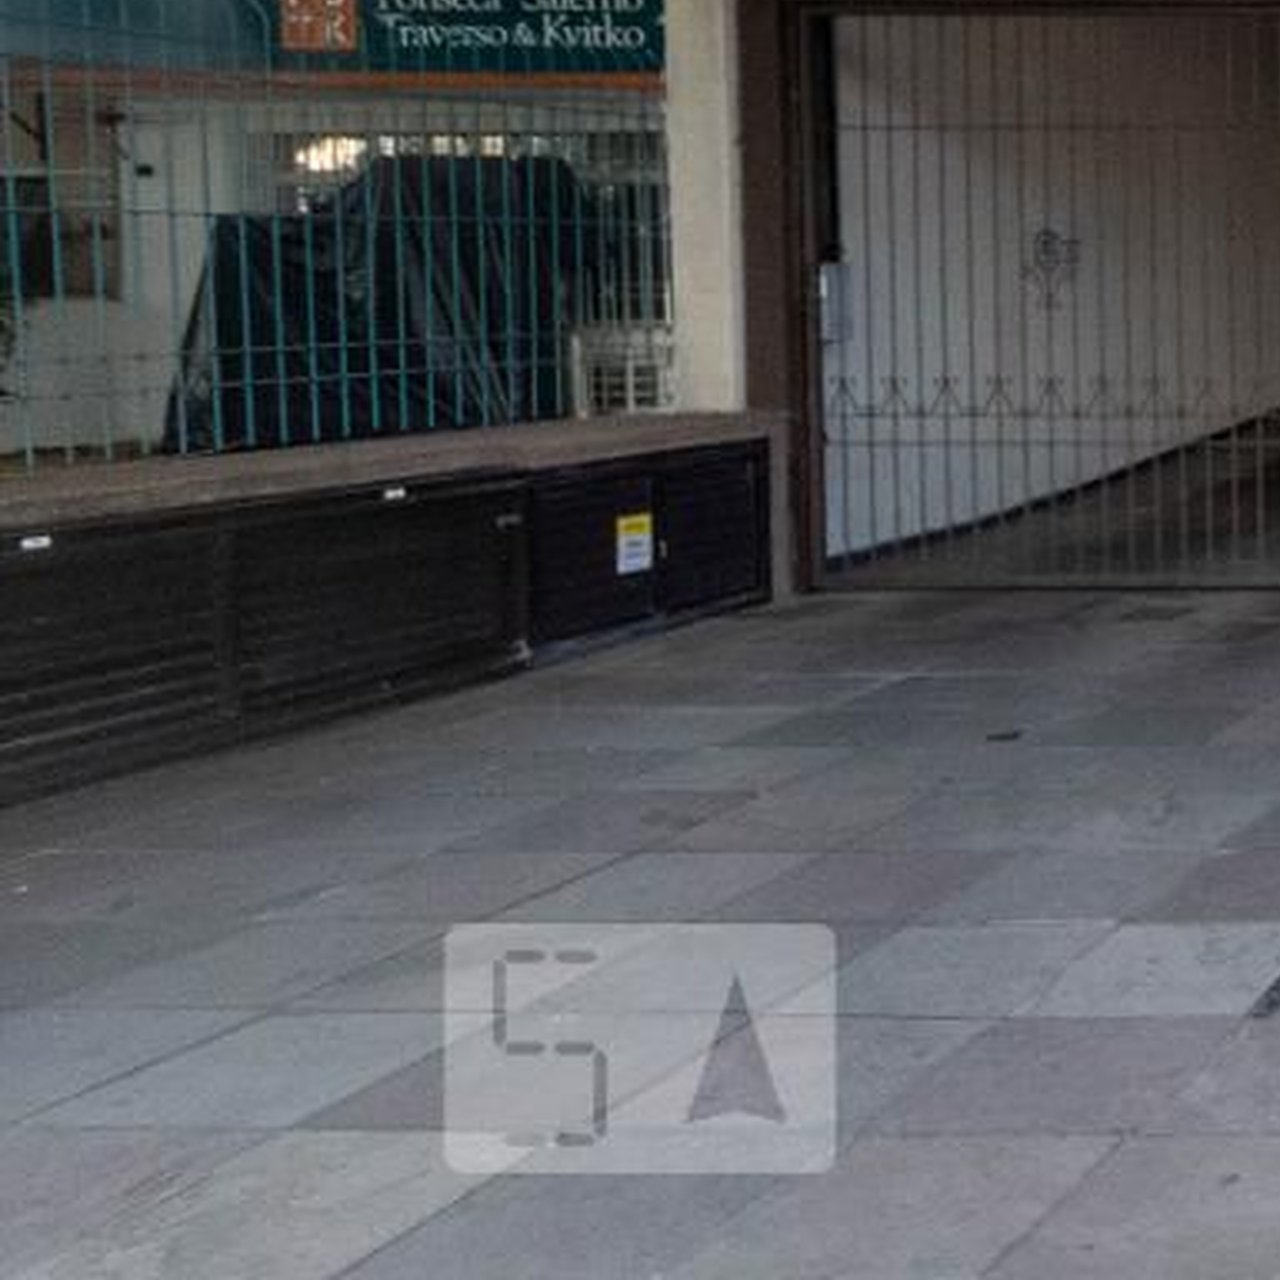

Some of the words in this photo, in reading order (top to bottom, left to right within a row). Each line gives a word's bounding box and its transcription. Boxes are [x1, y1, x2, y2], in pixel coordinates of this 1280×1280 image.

[376, 13, 507, 47] Traverso
[513, 21, 537, 46] &
[542, 13, 645, 47] Kvitko
